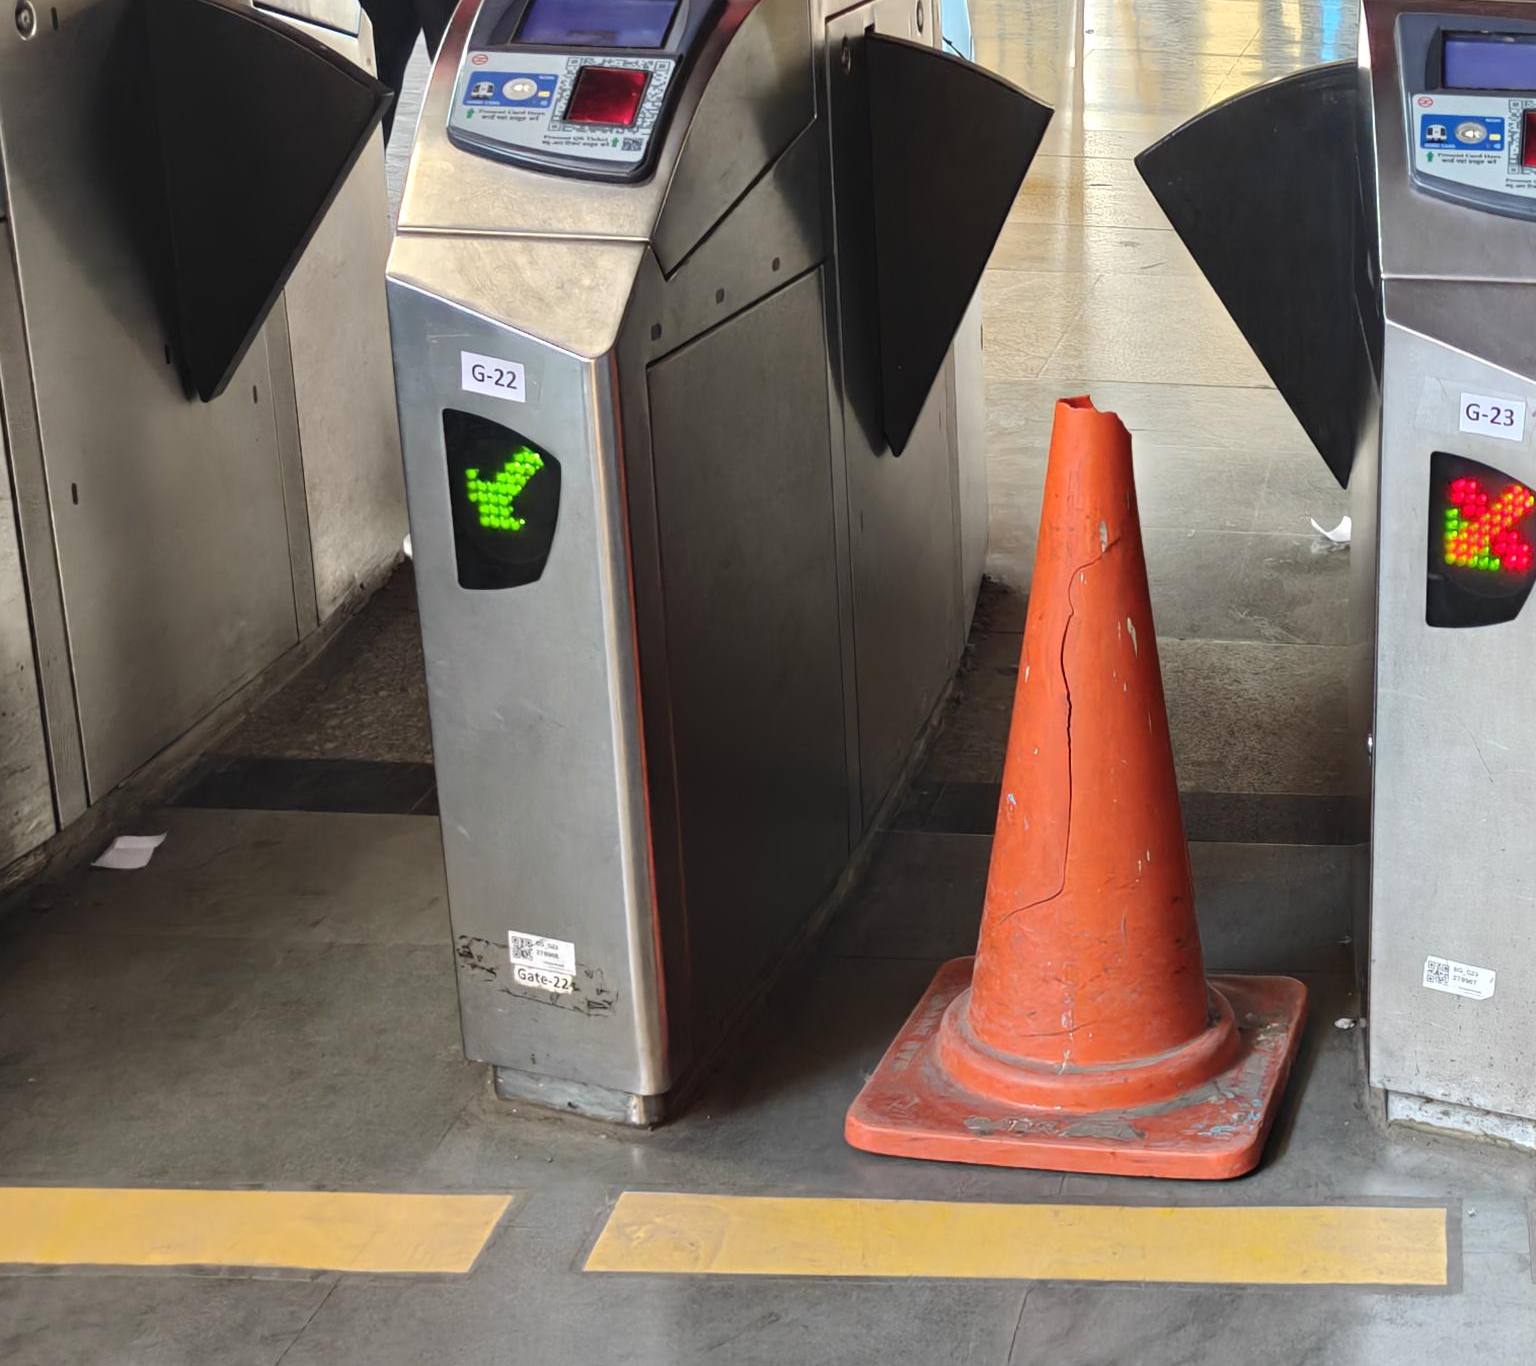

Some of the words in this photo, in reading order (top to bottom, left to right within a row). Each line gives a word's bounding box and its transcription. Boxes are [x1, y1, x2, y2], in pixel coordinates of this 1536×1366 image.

[472, 364, 518, 390] G-22
[1465, 403, 1514, 426] G-23
[517, 967, 570, 990] Gate-22
